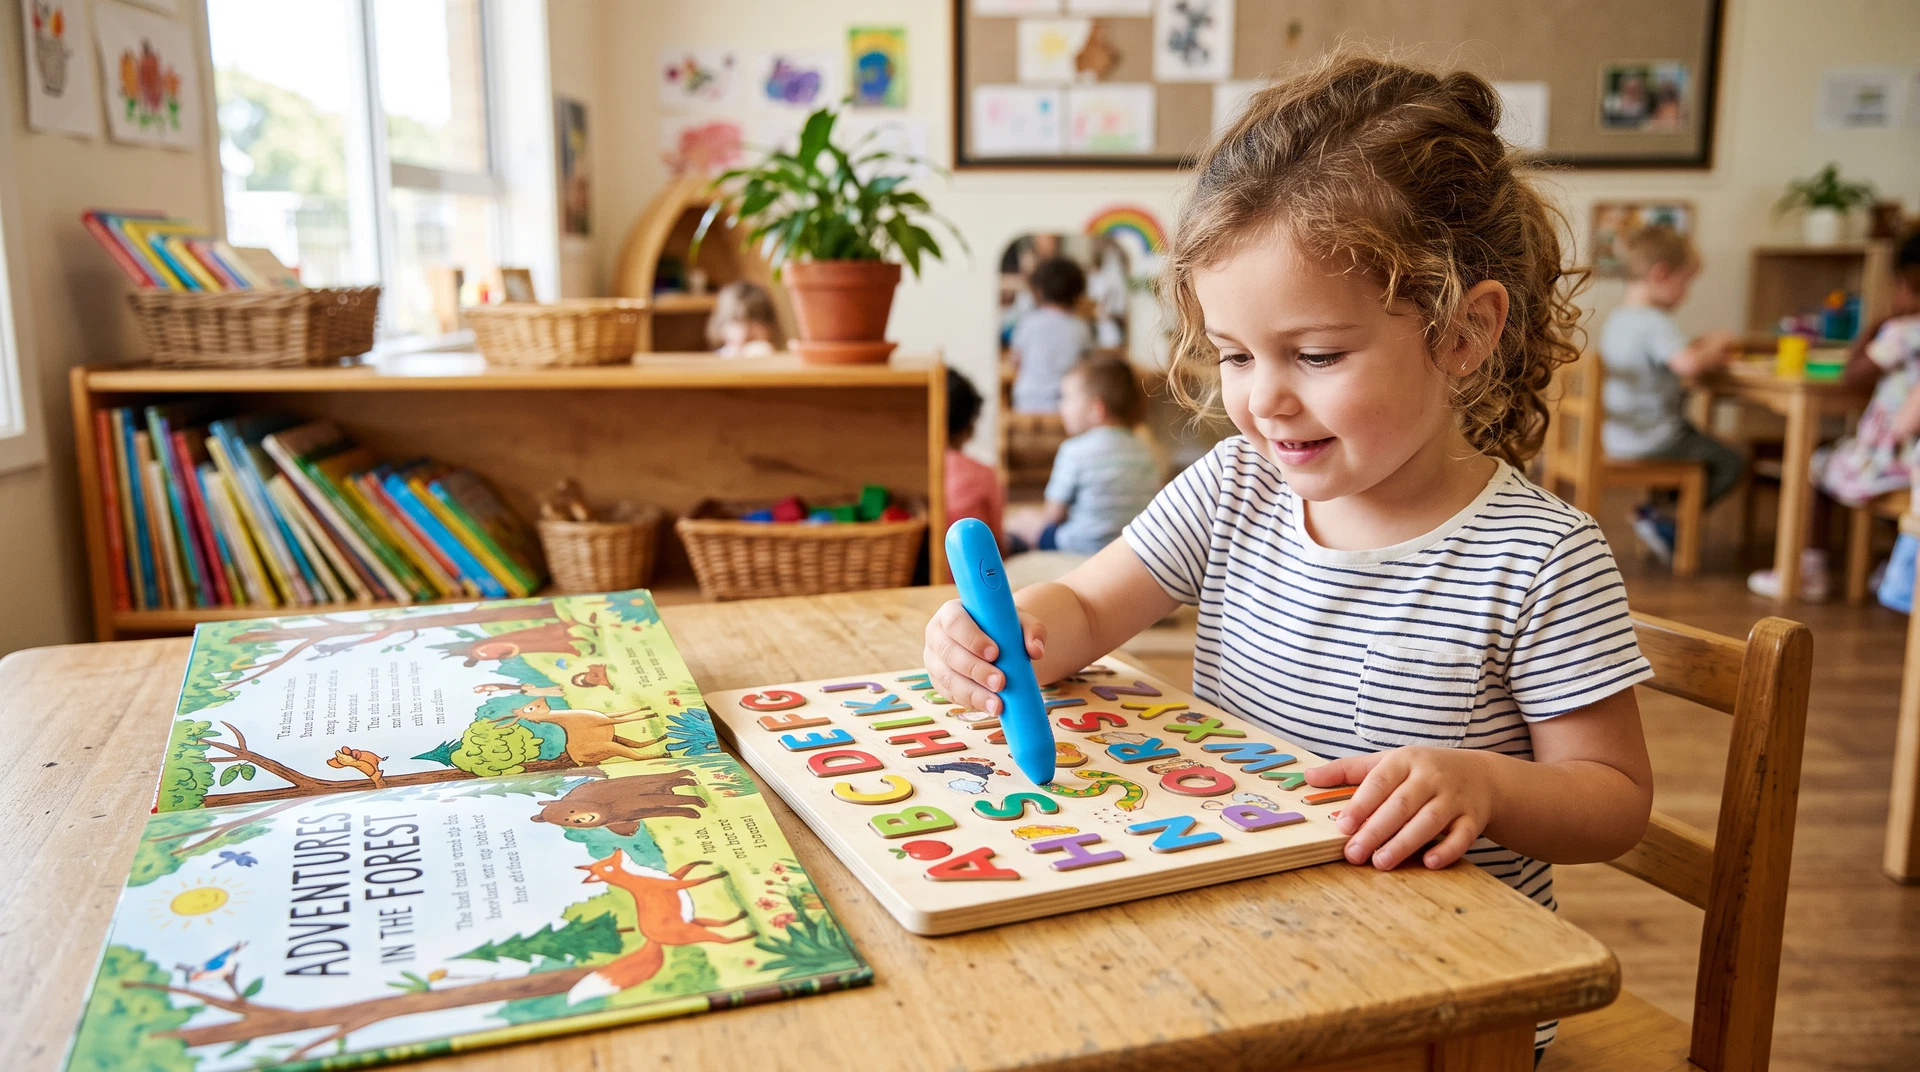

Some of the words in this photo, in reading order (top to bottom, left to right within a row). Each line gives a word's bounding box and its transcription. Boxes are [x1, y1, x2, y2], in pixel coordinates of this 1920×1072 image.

[740, 690, 807, 712] G
[820, 682, 886, 694] J
[842, 694, 913, 717] K
[1121, 702, 1190, 719] Y
[758, 713, 831, 732] F
[1057, 711, 1128, 732] S
[1164, 718, 1247, 743] X
[779, 729, 855, 752] E
[886, 729, 968, 758] H
[1106, 737, 1181, 764] R
[807, 750, 884, 778] D
[832, 775, 914, 805] C
[972, 792, 1060, 821] S
[1221, 804, 1307, 832] P
[869, 806, 957, 839] B
[363, 813, 424, 901] FOREST
[915, 847, 1021, 882] A
[1027, 833, 1126, 872] H
[285, 812, 351, 976] ADVENTURES
[379, 905, 413, 940] THE
[381, 943, 416, 964] IN
